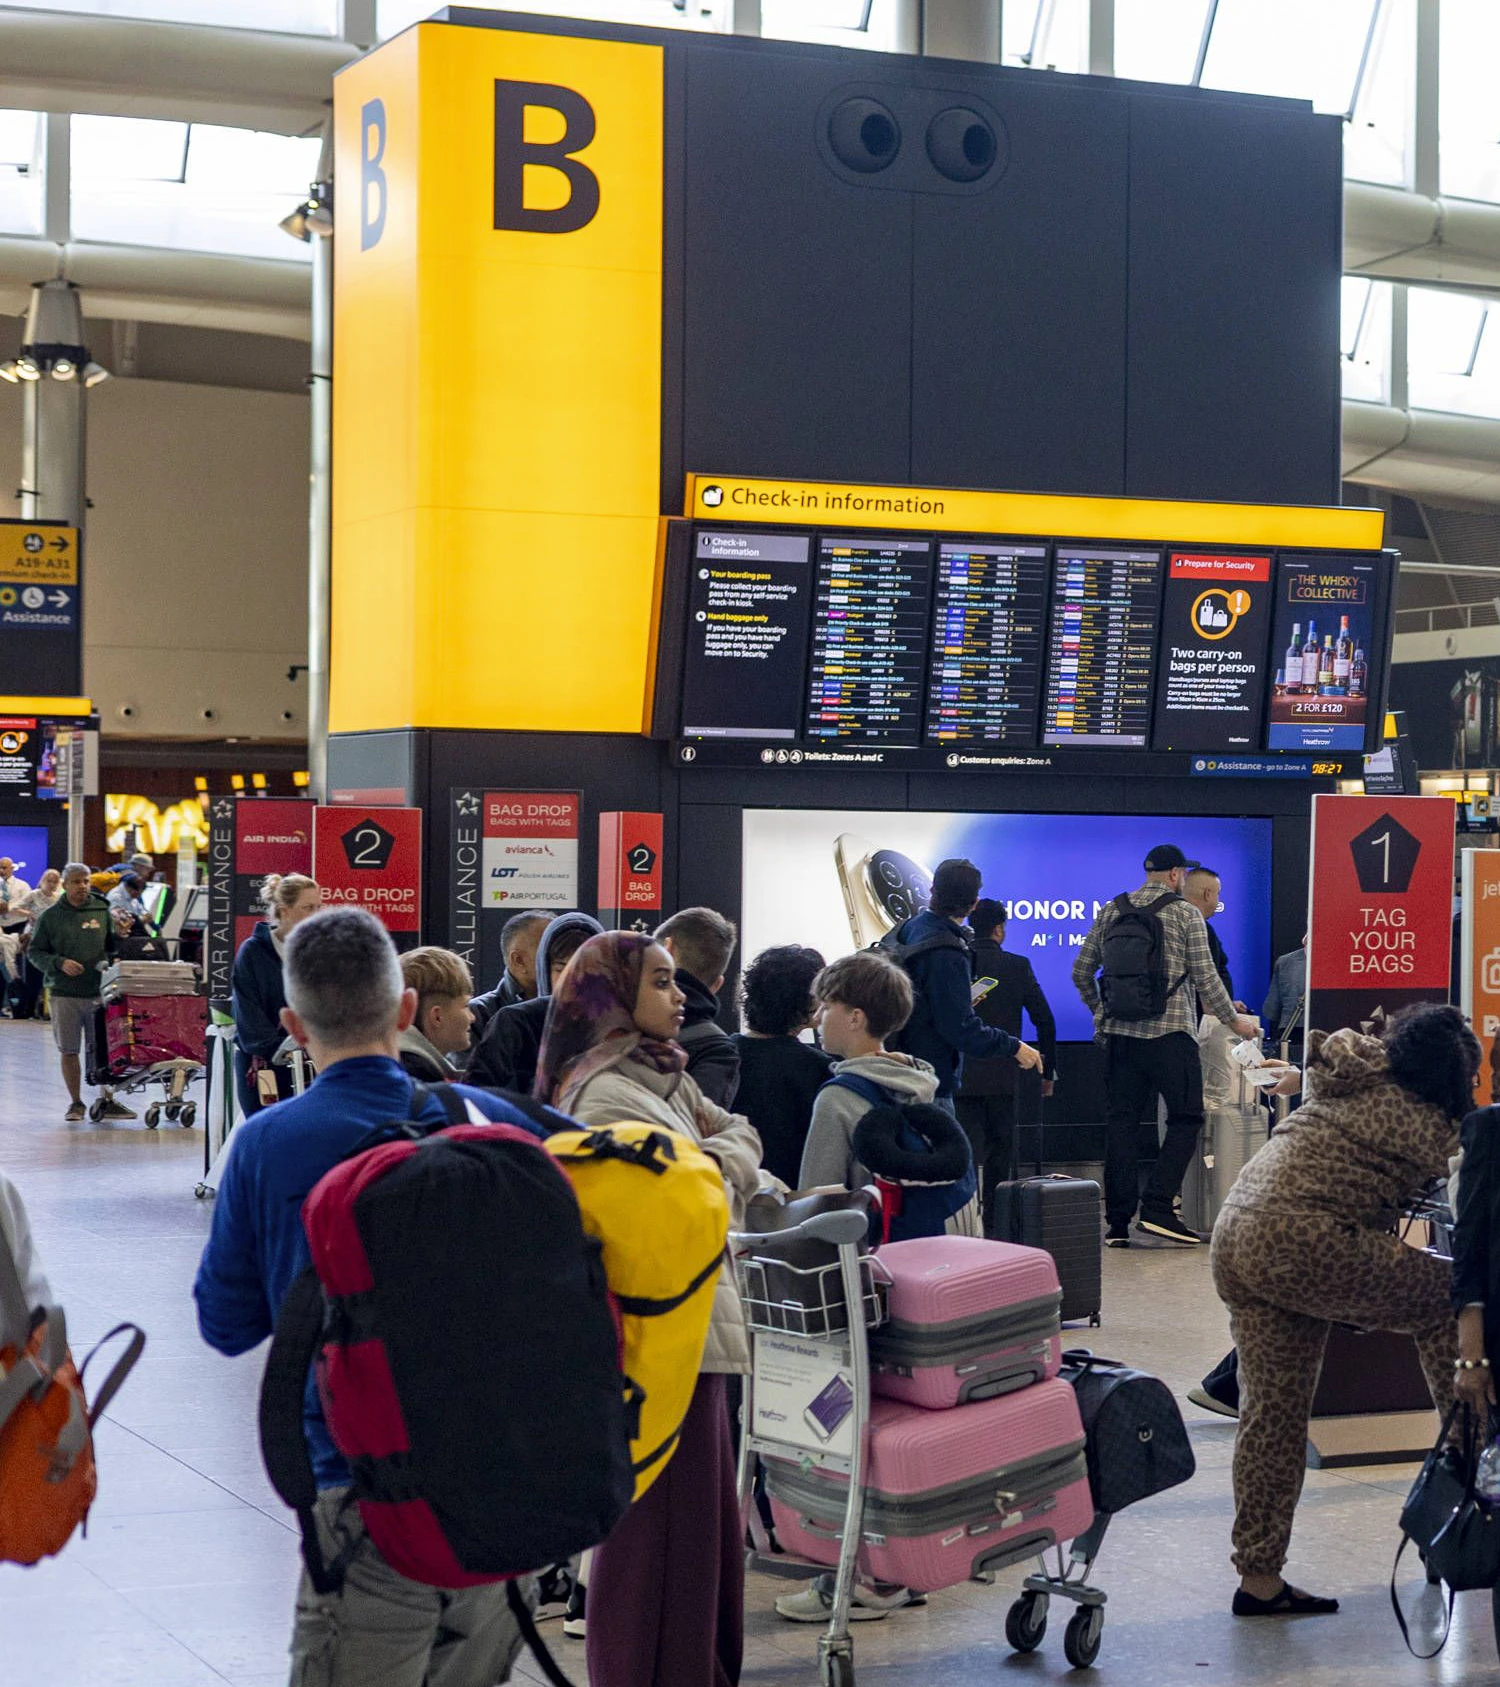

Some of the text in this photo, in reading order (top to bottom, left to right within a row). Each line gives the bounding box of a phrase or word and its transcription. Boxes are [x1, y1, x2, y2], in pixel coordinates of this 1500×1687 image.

[494, 78, 600, 234] B
[361, 98, 387, 252] B
[732, 488, 945, 515] Check-in information
[712, 538, 760, 556] Check-in information
[1184, 559, 1213, 569] Prepare
[1225, 561, 1256, 571] Security
[711, 570, 727, 579] Your
[728, 571, 756, 580] boarding
[1297, 574, 1359, 586] THE WHISKY
[1297, 587, 1358, 600] COLLECTIVE
[3, 611, 71, 624] Assistance
[726, 614, 753, 622] baggage
[1171, 647, 1242, 661] Two carry-on
[1170, 660, 1256, 674] bags per person
[1296, 704, 1343, 713] 2 FOR £120
[1303, 738, 1331, 746] Heathrow
[804, 752, 831, 761] Toilets:
[832, 753, 854, 761] Zones
[862, 754, 877, 762] and
[877, 754, 884, 762] C
[960, 756, 990, 764] Customs
[991, 757, 1026, 765] enquiries:
[1217, 762, 1262, 770] Assistance
[1311, 763, 1342, 774] 08:27
[490, 804, 571, 816] BAG DROP
[490, 817, 517, 825] BAGS
[243, 835, 301, 843] AIR INDIA
[354, 829, 382, 864] 2
[505, 845, 543, 854] avianca
[633, 849, 649, 871] 2
[1371, 831, 1390, 883] 1
[491, 868, 519, 878] LOT
[213, 829, 232, 942] ALLIANCE
[629, 882, 651, 891] BAG
[320, 888, 415, 901] BAG DROP
[456, 828, 478, 966] ALLIANCE
[625, 892, 655, 901] DROP
[386, 904, 415, 913] TAGS
[1360, 908, 1406, 927] TAG
[1350, 931, 1415, 950] YOUR
[1350, 955, 1415, 973] BAGS
